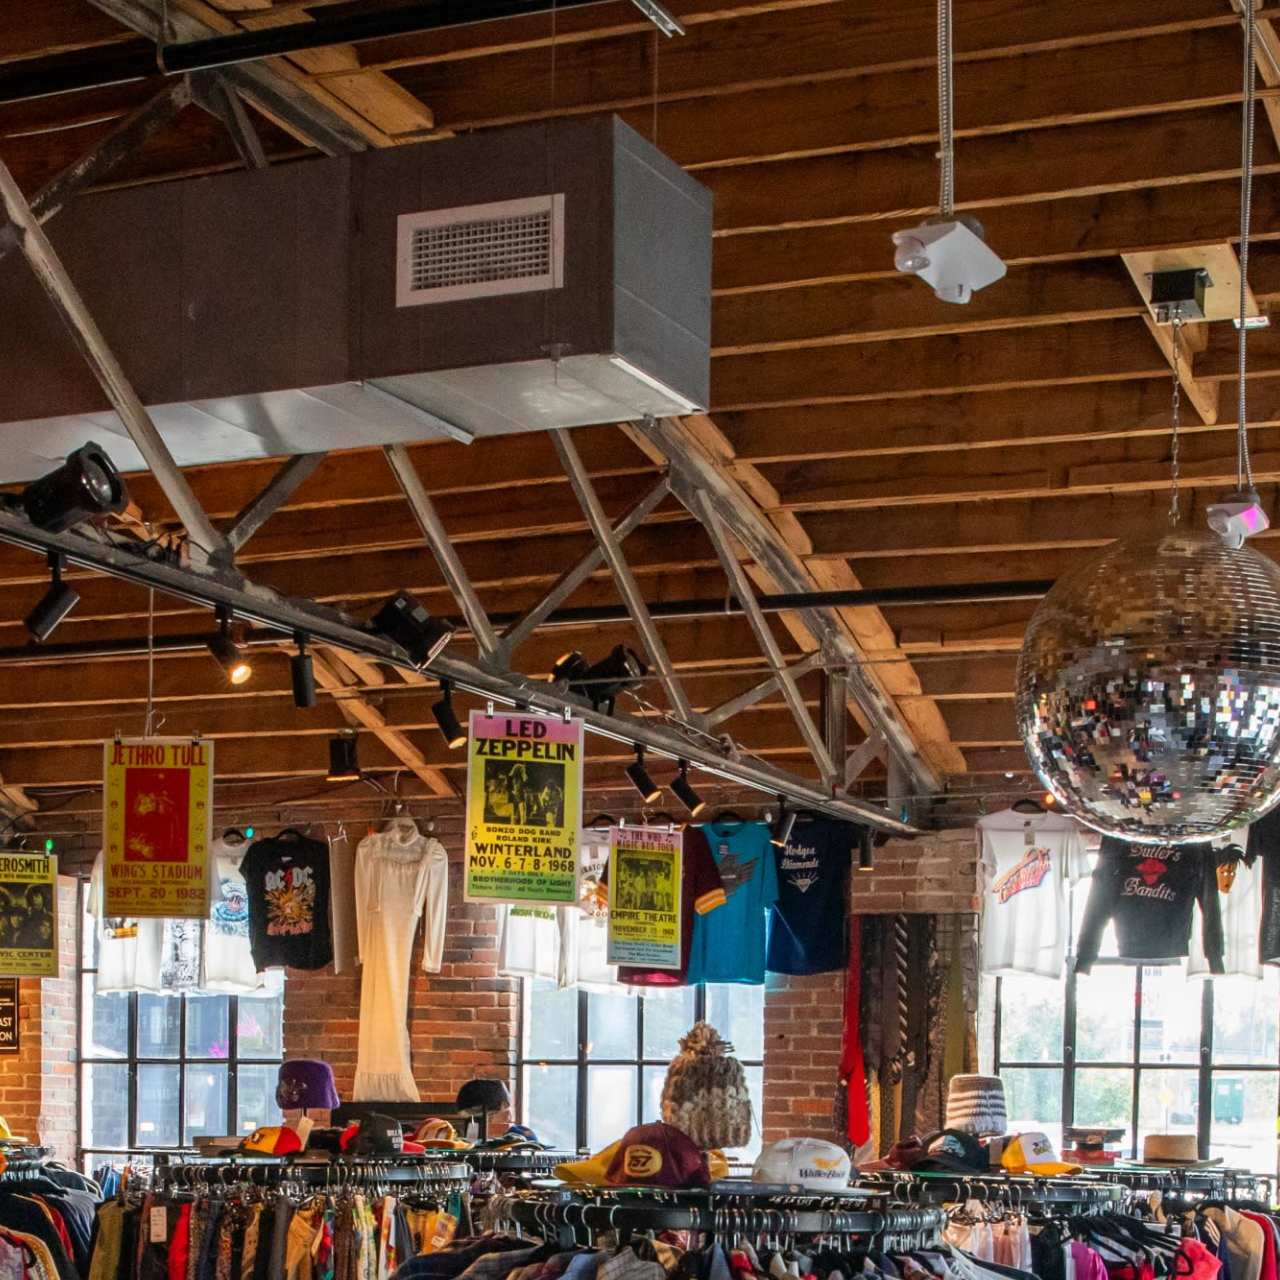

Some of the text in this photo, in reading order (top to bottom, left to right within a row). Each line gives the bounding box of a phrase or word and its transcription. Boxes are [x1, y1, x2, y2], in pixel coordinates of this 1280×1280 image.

[505, 719, 547, 738] LED
[111, 745, 207, 766] JETHRO TULL
[475, 738, 575, 761] ZEPPELIN
[475, 843, 572, 859] WINTERLAND
[470, 855, 500, 868] NOV.
[111, 863, 202, 880] WING'S STADIUM
[610, 910, 641, 921] EMPIRE
